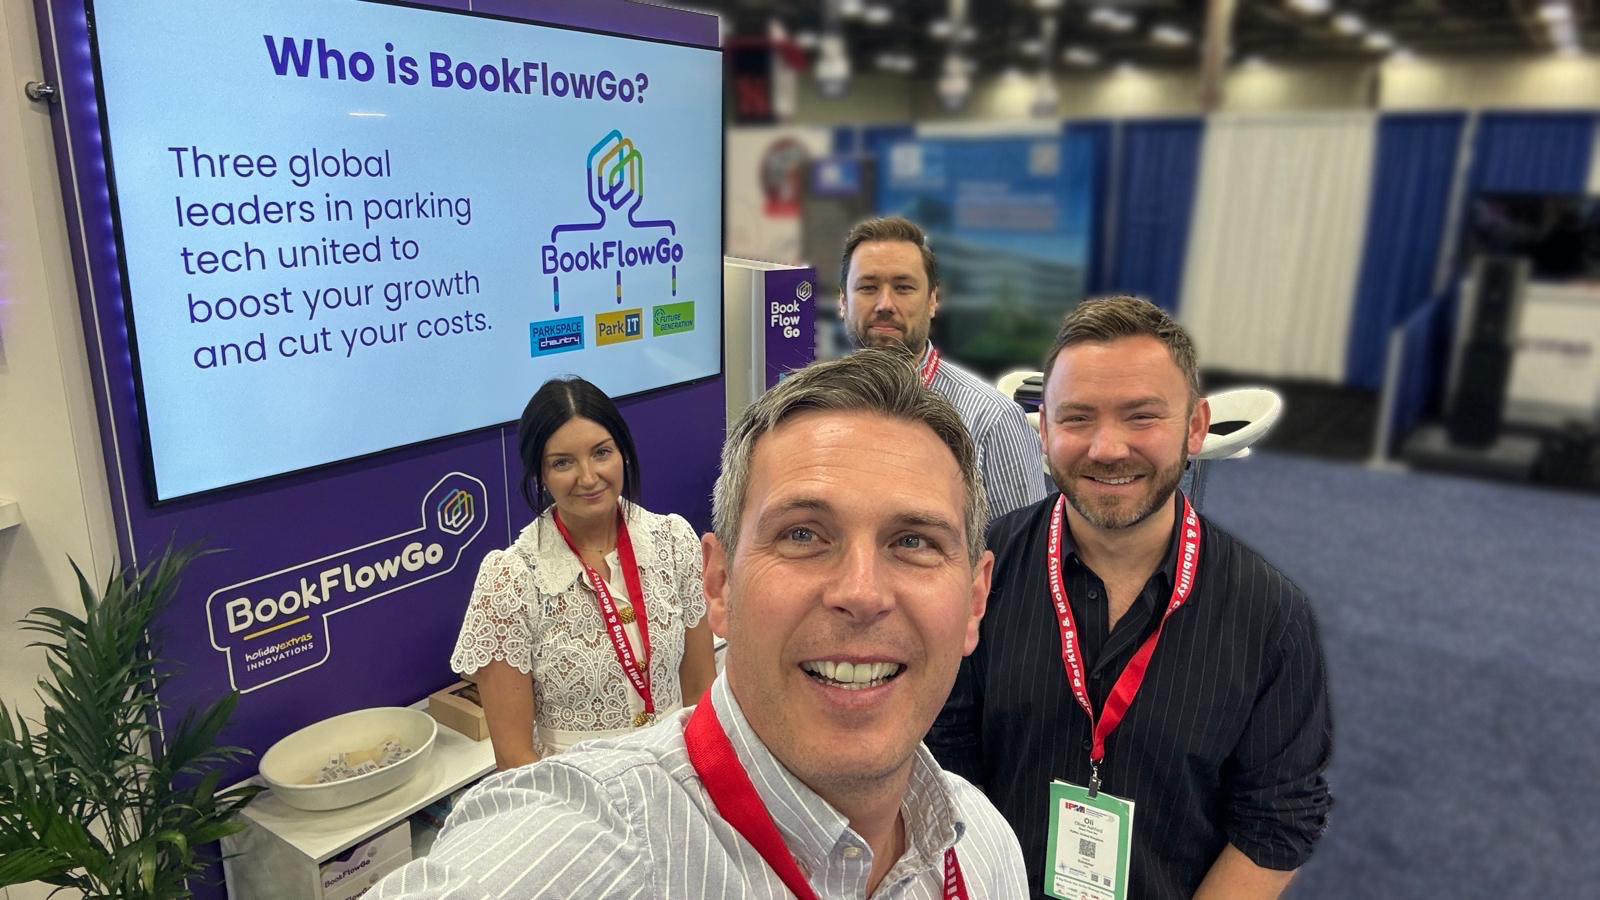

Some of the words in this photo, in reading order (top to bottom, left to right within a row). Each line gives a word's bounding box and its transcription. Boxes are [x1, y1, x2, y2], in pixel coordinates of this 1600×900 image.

[264, 35, 375, 82] Who
[385, 43, 420, 86] is
[430, 52, 649, 104] BookFlowGo?
[168, 147, 277, 178] Three
[290, 148, 391, 188] global
[176, 193, 315, 227] leaders
[326, 193, 353, 222] in
[364, 191, 471, 230] parking
[181, 241, 266, 275] tech
[279, 235, 382, 269] united
[391, 237, 419, 261] to
[541, 238, 684, 275] BookFlowGo
[188, 286, 294, 324] boost
[303, 285, 374, 321] your
[384, 270, 480, 312] growth
[771, 299, 801, 314] Book
[533, 321, 582, 337] PARKSPACE
[660, 313, 682, 323] FUTURE
[771, 314, 801, 328] Flow
[783, 326, 801, 339] Go
[194, 332, 267, 369] and
[279, 327, 333, 358] cut
[341, 321, 408, 358] your
[417, 310, 493, 339] costs.
[1186, 529, 1197, 539] &
[225, 543, 444, 634] BookFlowGo
[1049, 557, 1067, 614] Mobility
[1176, 541, 1196, 598] Mobility
[591, 572, 614, 614] Mobility
[608, 615, 617, 624] &
[1062, 616, 1071, 627] &
[246, 642, 314, 672] INNOVATIONS
[613, 624, 635, 669] Parking
[1065, 630, 1082, 687] Parking
[324, 859, 371, 889] BookFlowGo
